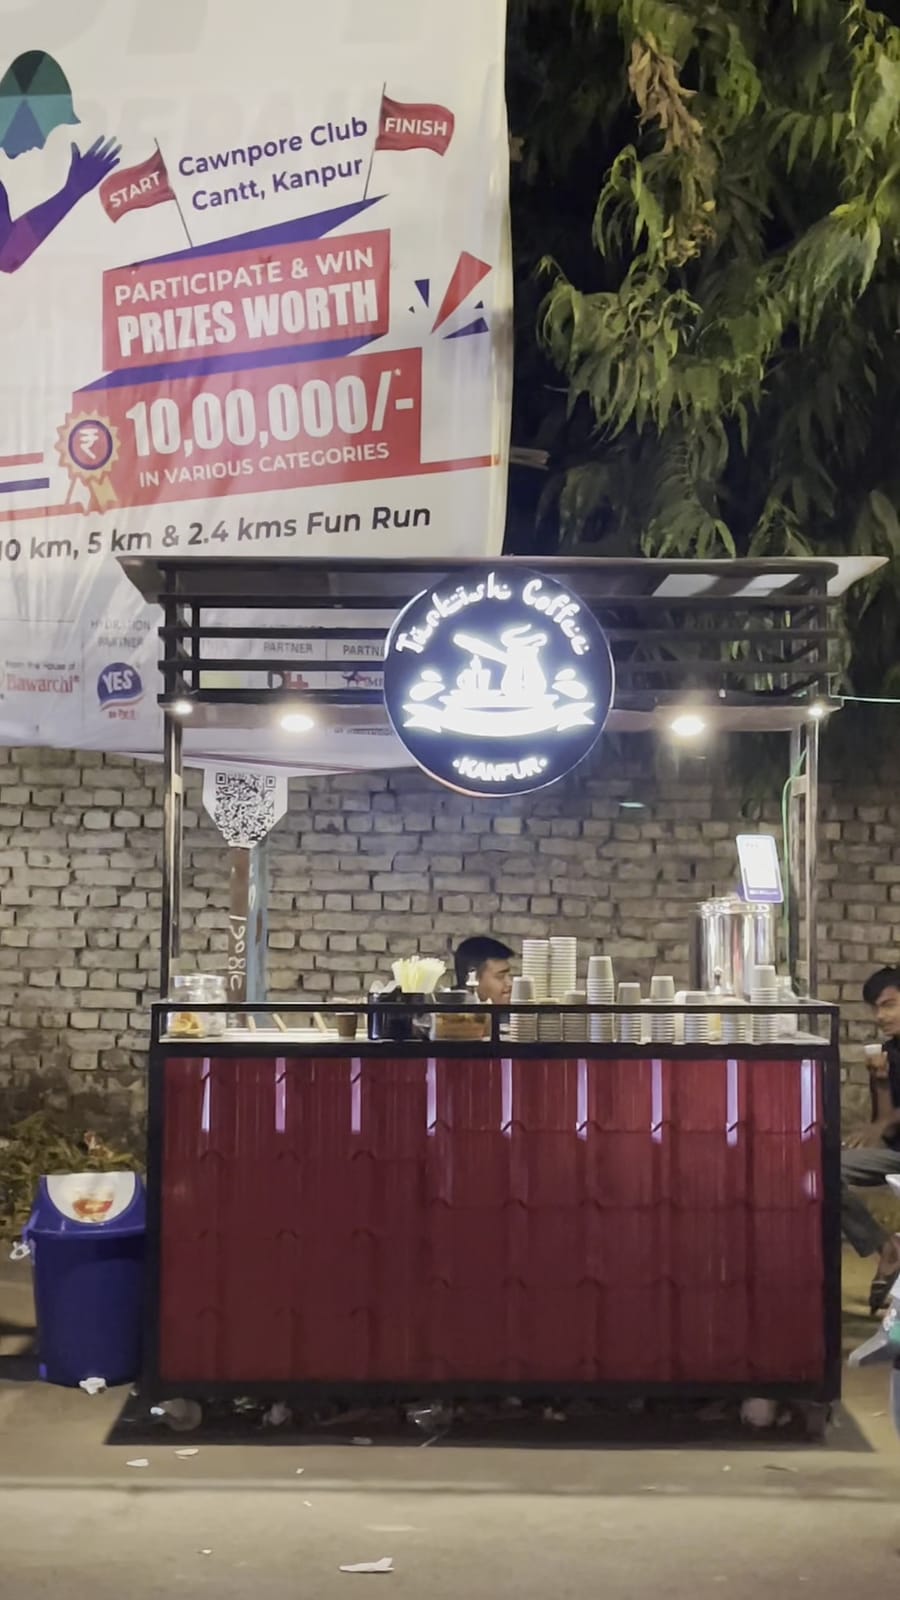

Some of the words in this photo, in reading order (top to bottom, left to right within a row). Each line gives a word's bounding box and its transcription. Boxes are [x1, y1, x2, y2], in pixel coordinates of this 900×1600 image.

[178, 133, 304, 177] Cawnpore
[310, 117, 369, 149] Club
[384, 117, 447, 138] FINISH
[109, 171, 162, 209] START
[191, 177, 266, 212] Cantt,
[272, 157, 363, 195] Kanpur
[114, 260, 284, 306] PARTICIPATE
[291, 257, 309, 279] &
[315, 248, 374, 277] WIN
[117, 300, 237, 357] PRIZES
[242, 279, 379, 339] WORTH
[139, 470, 160, 488] IN
[163, 458, 254, 486] VARIOUS
[258, 442, 390, 473] CATEGORIES
[30, 536, 79, 560] km,
[88, 531, 102, 554] 5
[111, 529, 152, 552] km
[162, 524, 179, 548] &
[188, 520, 229, 546] 2.4
[237, 515, 298, 542] kms
[306, 511, 361, 536] Fun
[371, 505, 431, 530] Run
[264, 641, 312, 653] PARTNER
[102, 669, 134, 694] YES
[458, 757, 540, 781] KANPUR
